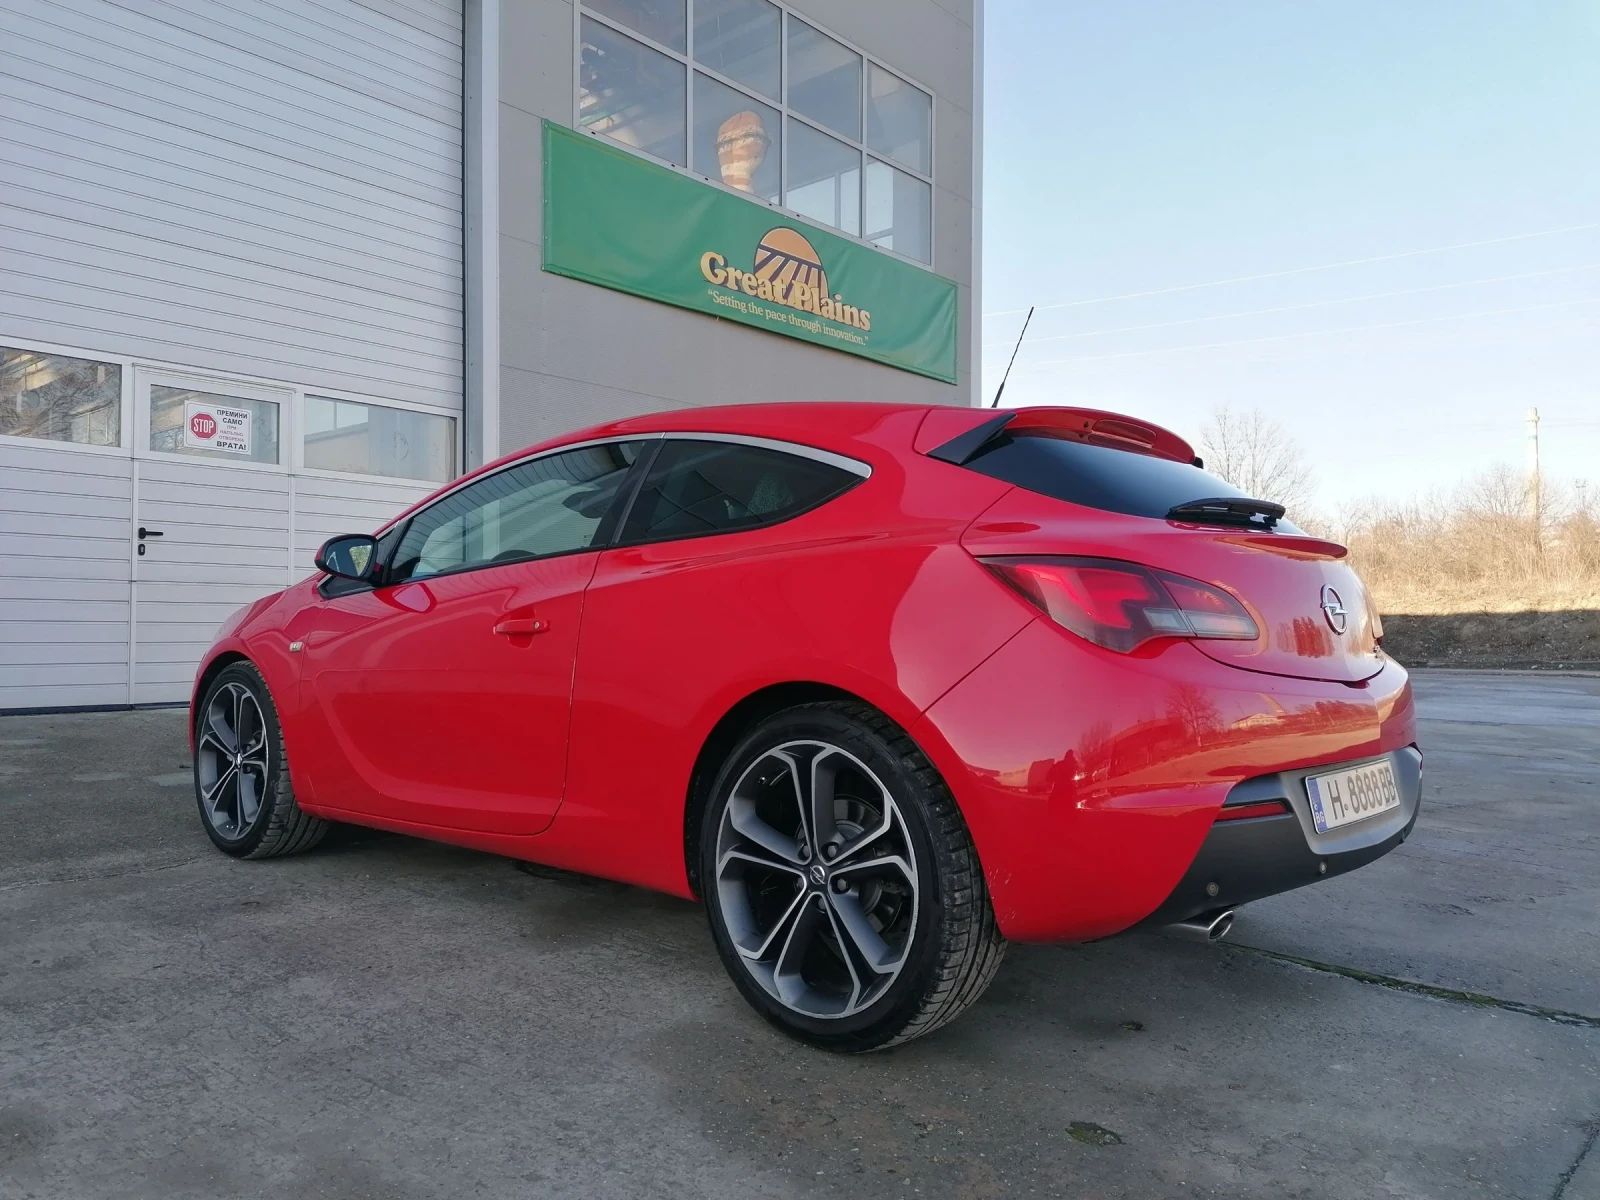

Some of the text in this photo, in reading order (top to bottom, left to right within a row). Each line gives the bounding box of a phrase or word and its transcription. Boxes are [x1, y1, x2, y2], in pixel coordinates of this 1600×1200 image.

[700, 251, 871, 331] Great Plains
[747, 301, 764, 316] the
[765, 309, 787, 323] pace
[788, 314, 822, 333] through
[216, 409, 248, 420] ПРЕМИНИ
[193, 418, 214, 433] STOP
[216, 441, 247, 450] ВРАТА!
[1315, 811, 1325, 824] BG
